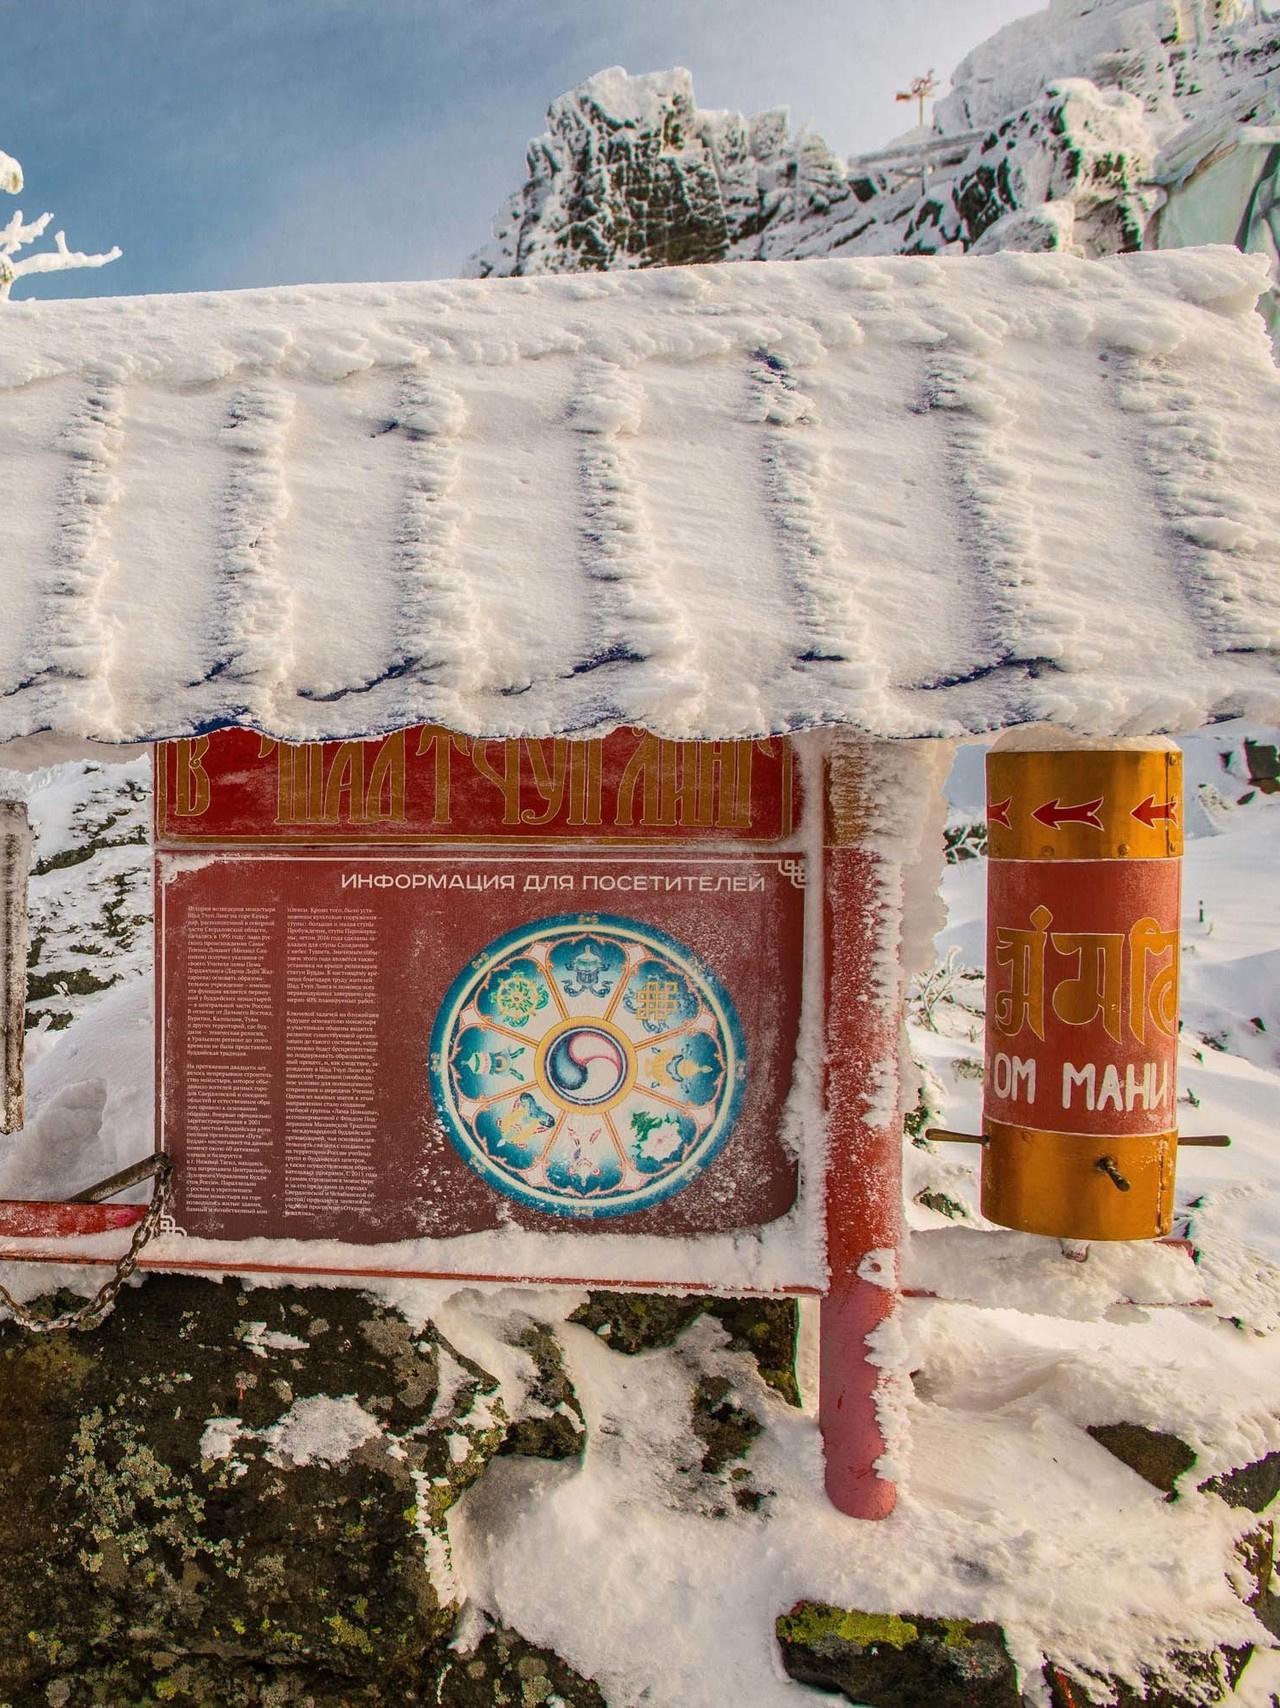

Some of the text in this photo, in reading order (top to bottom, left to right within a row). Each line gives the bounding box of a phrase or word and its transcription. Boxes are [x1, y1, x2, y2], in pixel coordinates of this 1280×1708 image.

[341, 872, 765, 892] ИНФОРМАЦИЯ ДЛЯ ПОСЕТИТЕЛЕЙ
[994, 1052, 1168, 1111] ОМ МАНИ
